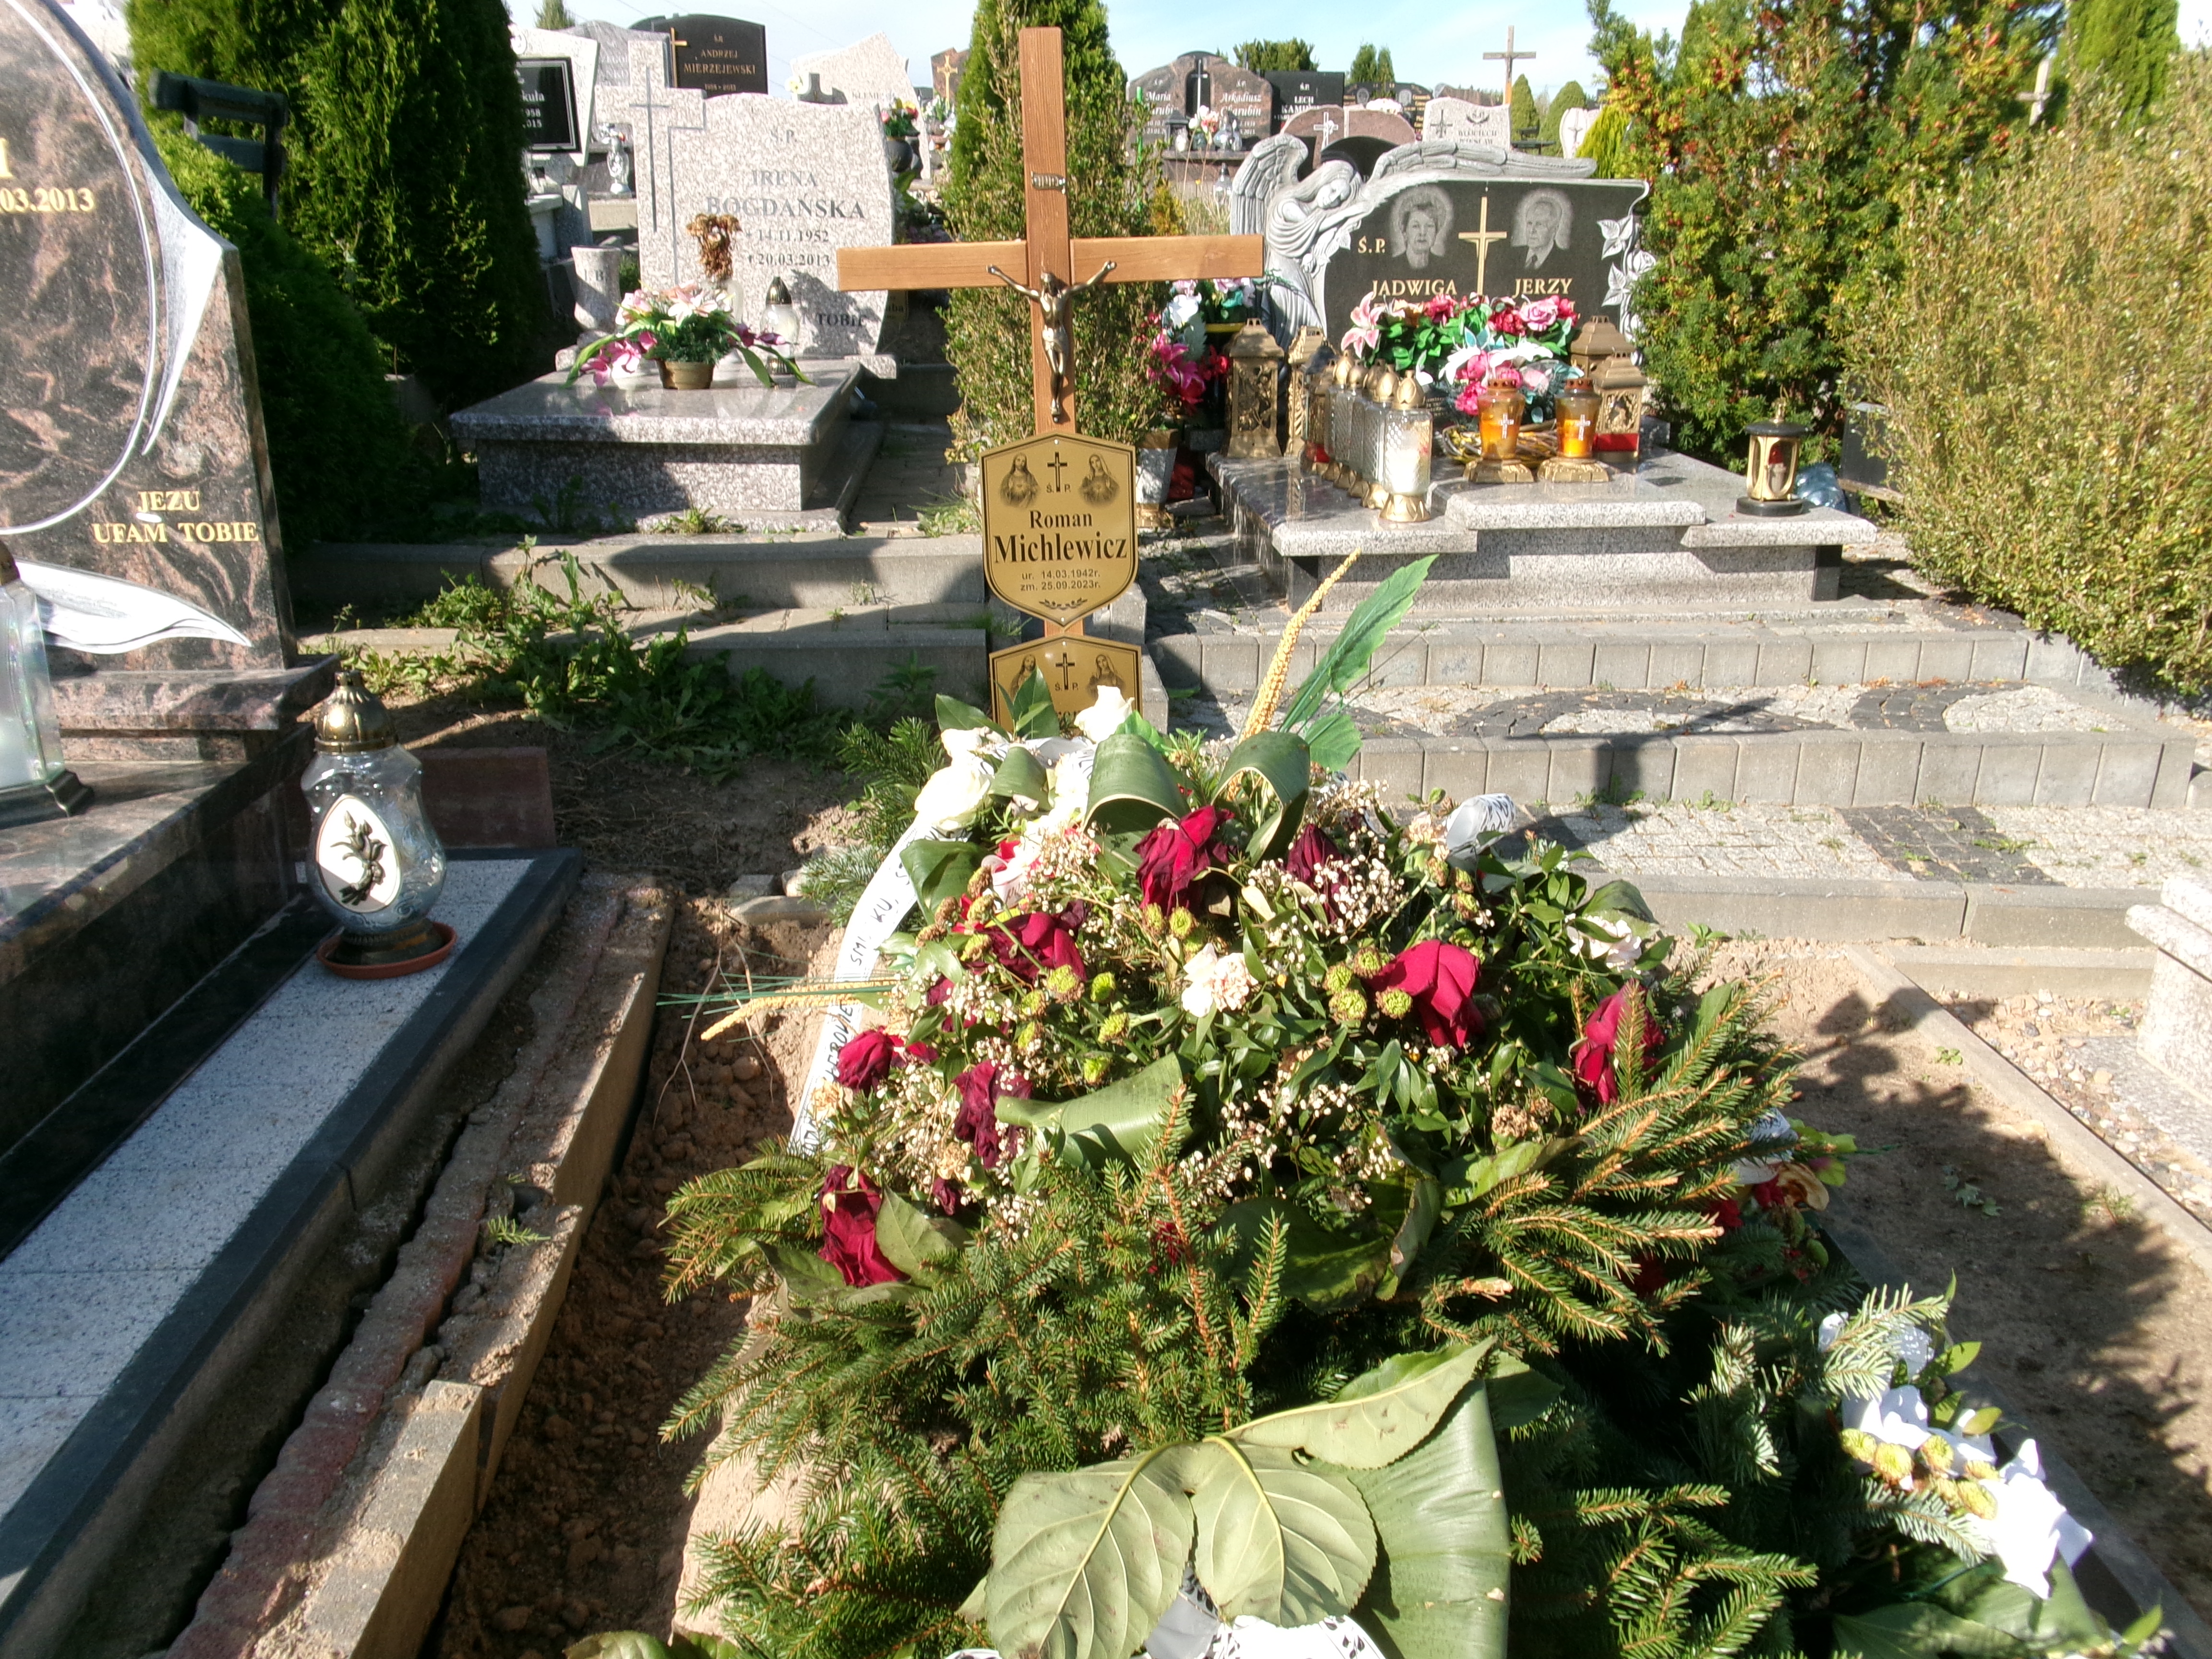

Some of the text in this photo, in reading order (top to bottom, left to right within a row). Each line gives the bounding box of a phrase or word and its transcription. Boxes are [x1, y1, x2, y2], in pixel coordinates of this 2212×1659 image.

[700, 49, 738, 59] ANDRZEJ
[1146, 90, 1172, 102] Maria
[1220, 91, 1262, 104] Arkadiusz
[1294, 95, 1314, 104] LECH
[0, 187, 95, 213] 03.2013
[706, 193, 866, 219] BOGDAŃSKA
[1372, 277, 1573, 299] JADWIGA JERZY
[137, 491, 200, 512] JEZU
[1030, 510, 1092, 529] Roman
[91, 522, 260, 543] UFAM TOBIE
[994, 530, 1127, 563] Michlewicz
[1022, 568, 1101, 580] ur. 14.03.1942r.
[1020, 579, 1101, 591] zm. 25.09.2023r.
